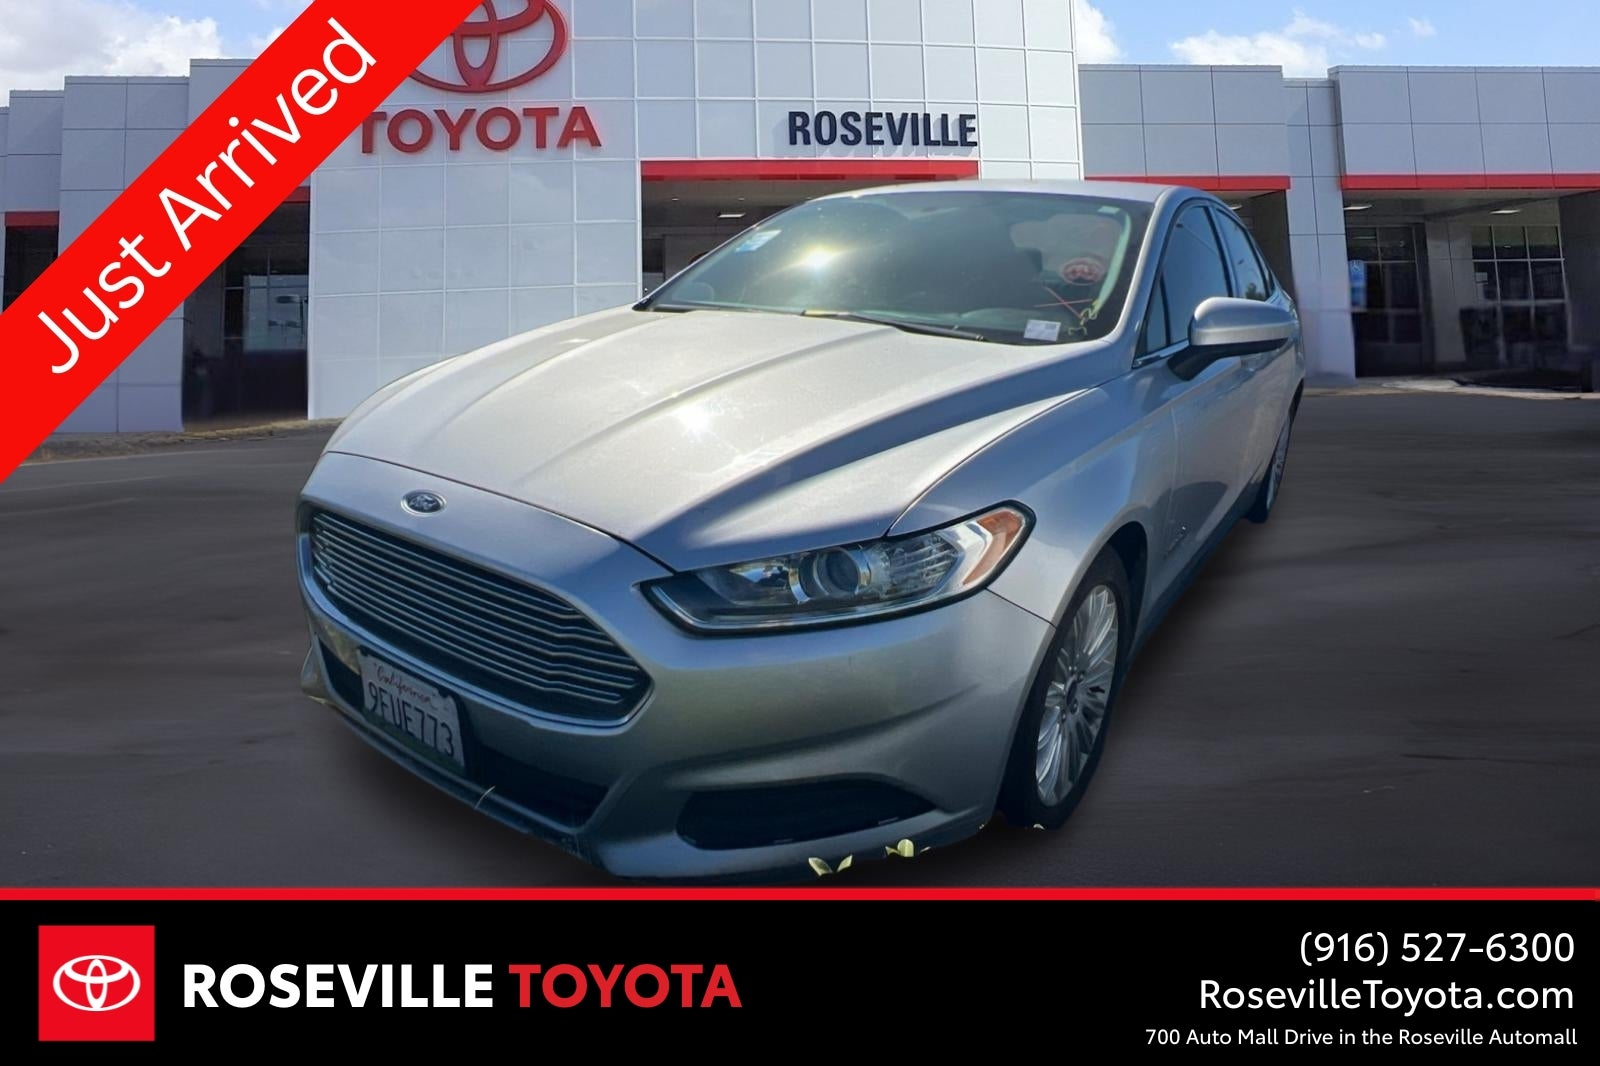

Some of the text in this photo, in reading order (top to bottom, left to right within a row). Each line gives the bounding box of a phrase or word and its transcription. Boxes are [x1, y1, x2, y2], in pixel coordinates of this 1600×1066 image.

[362, 106, 602, 154] TOYOTA
[788, 111, 978, 147] ROSEVILLE
[368, 681, 455, 757] 9FUE773
